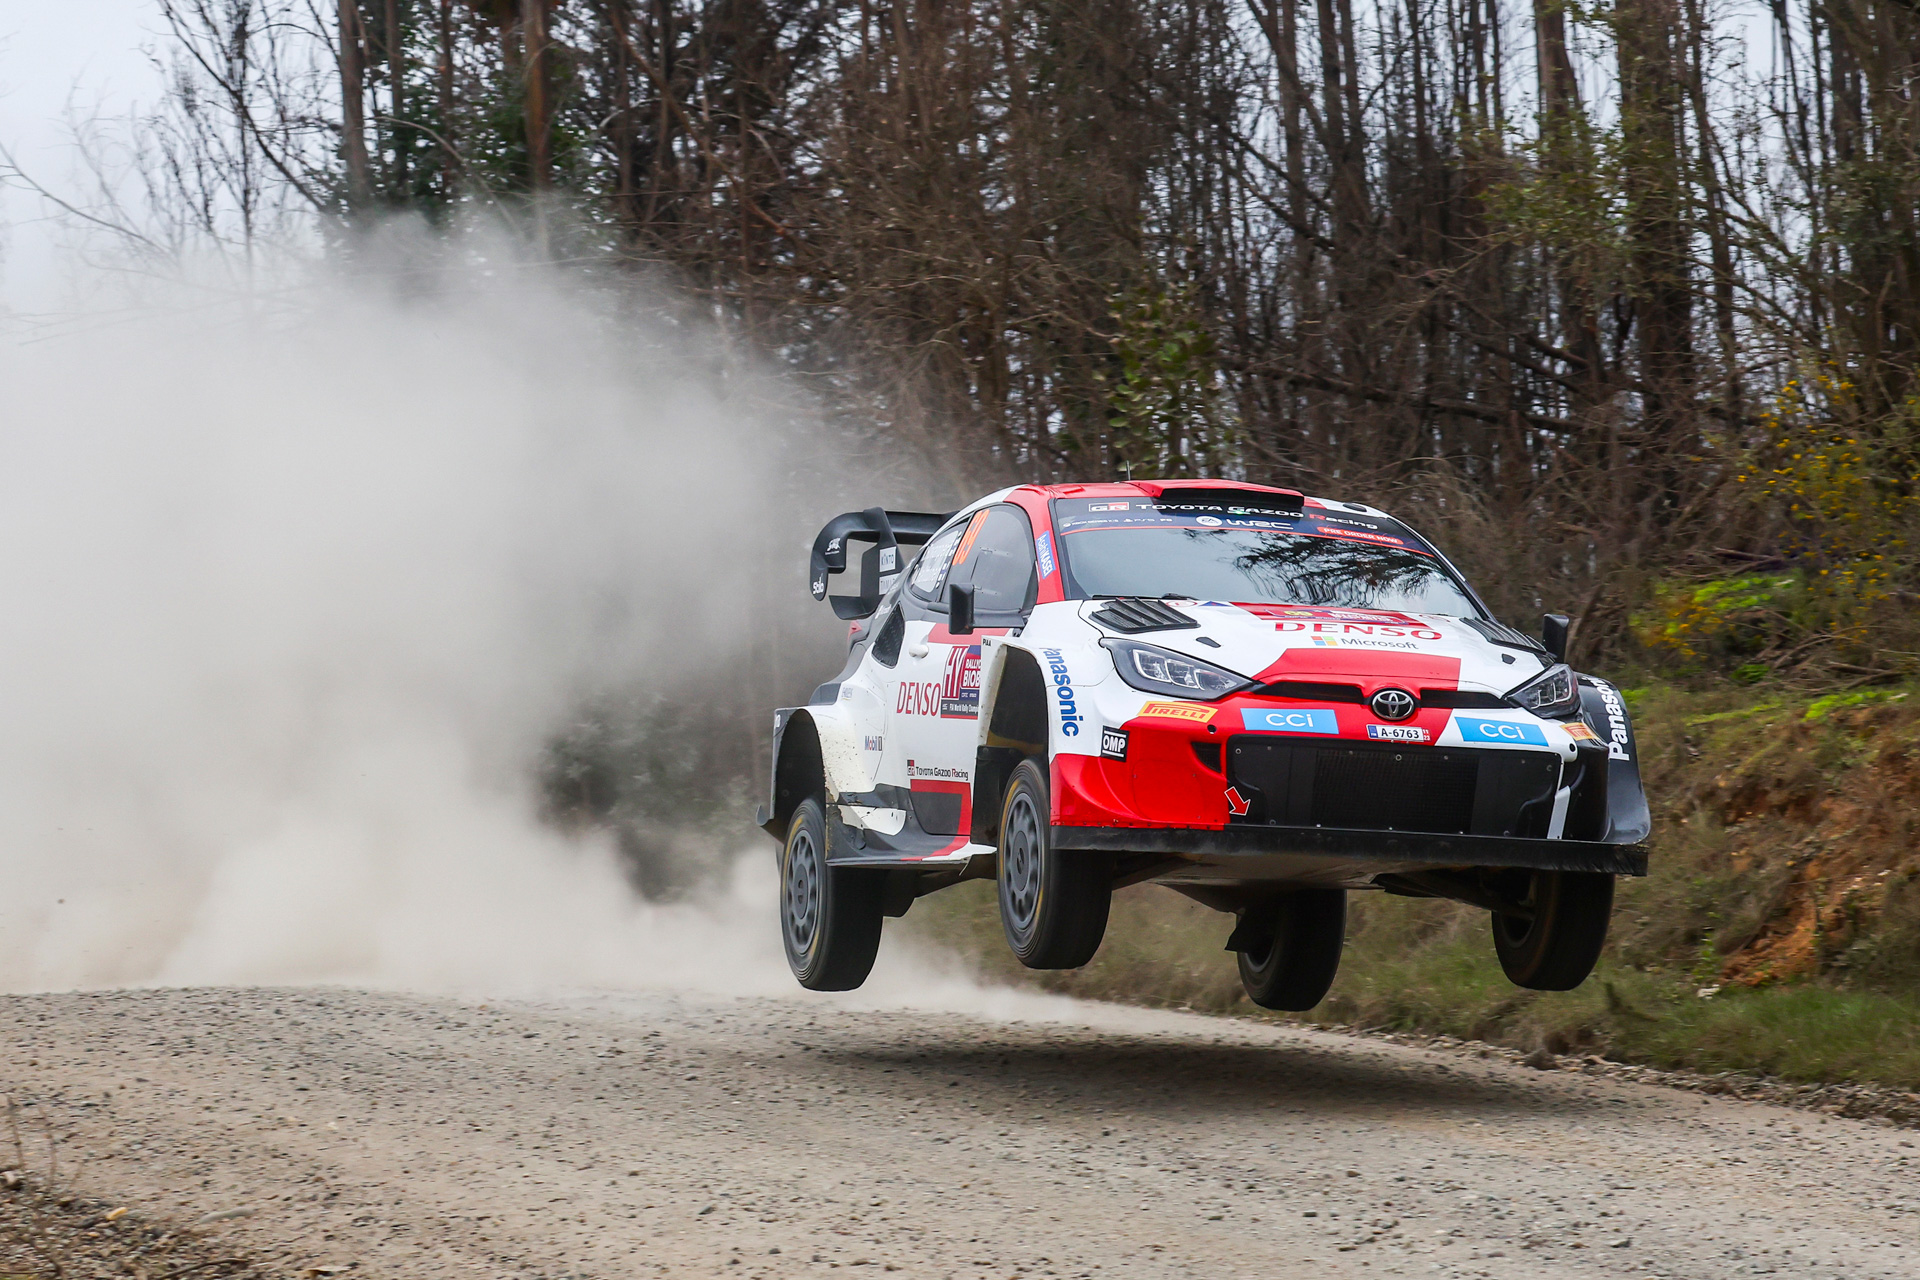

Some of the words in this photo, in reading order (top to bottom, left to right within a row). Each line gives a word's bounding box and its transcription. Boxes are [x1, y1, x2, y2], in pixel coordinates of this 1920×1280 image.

[1090, 503, 1129, 512] GR
[1135, 504, 1223, 512] TOYOTA
[1227, 506, 1304, 518] GAZOO
[1308, 513, 1378, 531] Racing
[1227, 518, 1294, 530] WRC
[1323, 527, 1344, 536] PRE
[1345, 530, 1375, 540] ORDER
[1376, 534, 1399, 544] NOW
[1274, 622, 1443, 640] DENSO
[1341, 638, 1419, 650] Microsoft
[896, 681, 941, 717] DENSO
[1143, 703, 1211, 720] PIRELLI
[1381, 727, 1420, 739] A-6763
[864, 735, 878, 751] Mobil
[1102, 734, 1126, 753] OMP
[916, 766, 934, 776] TOYOTA
[934, 767, 951, 777] GAZOO
[952, 768, 969, 781] Racing
